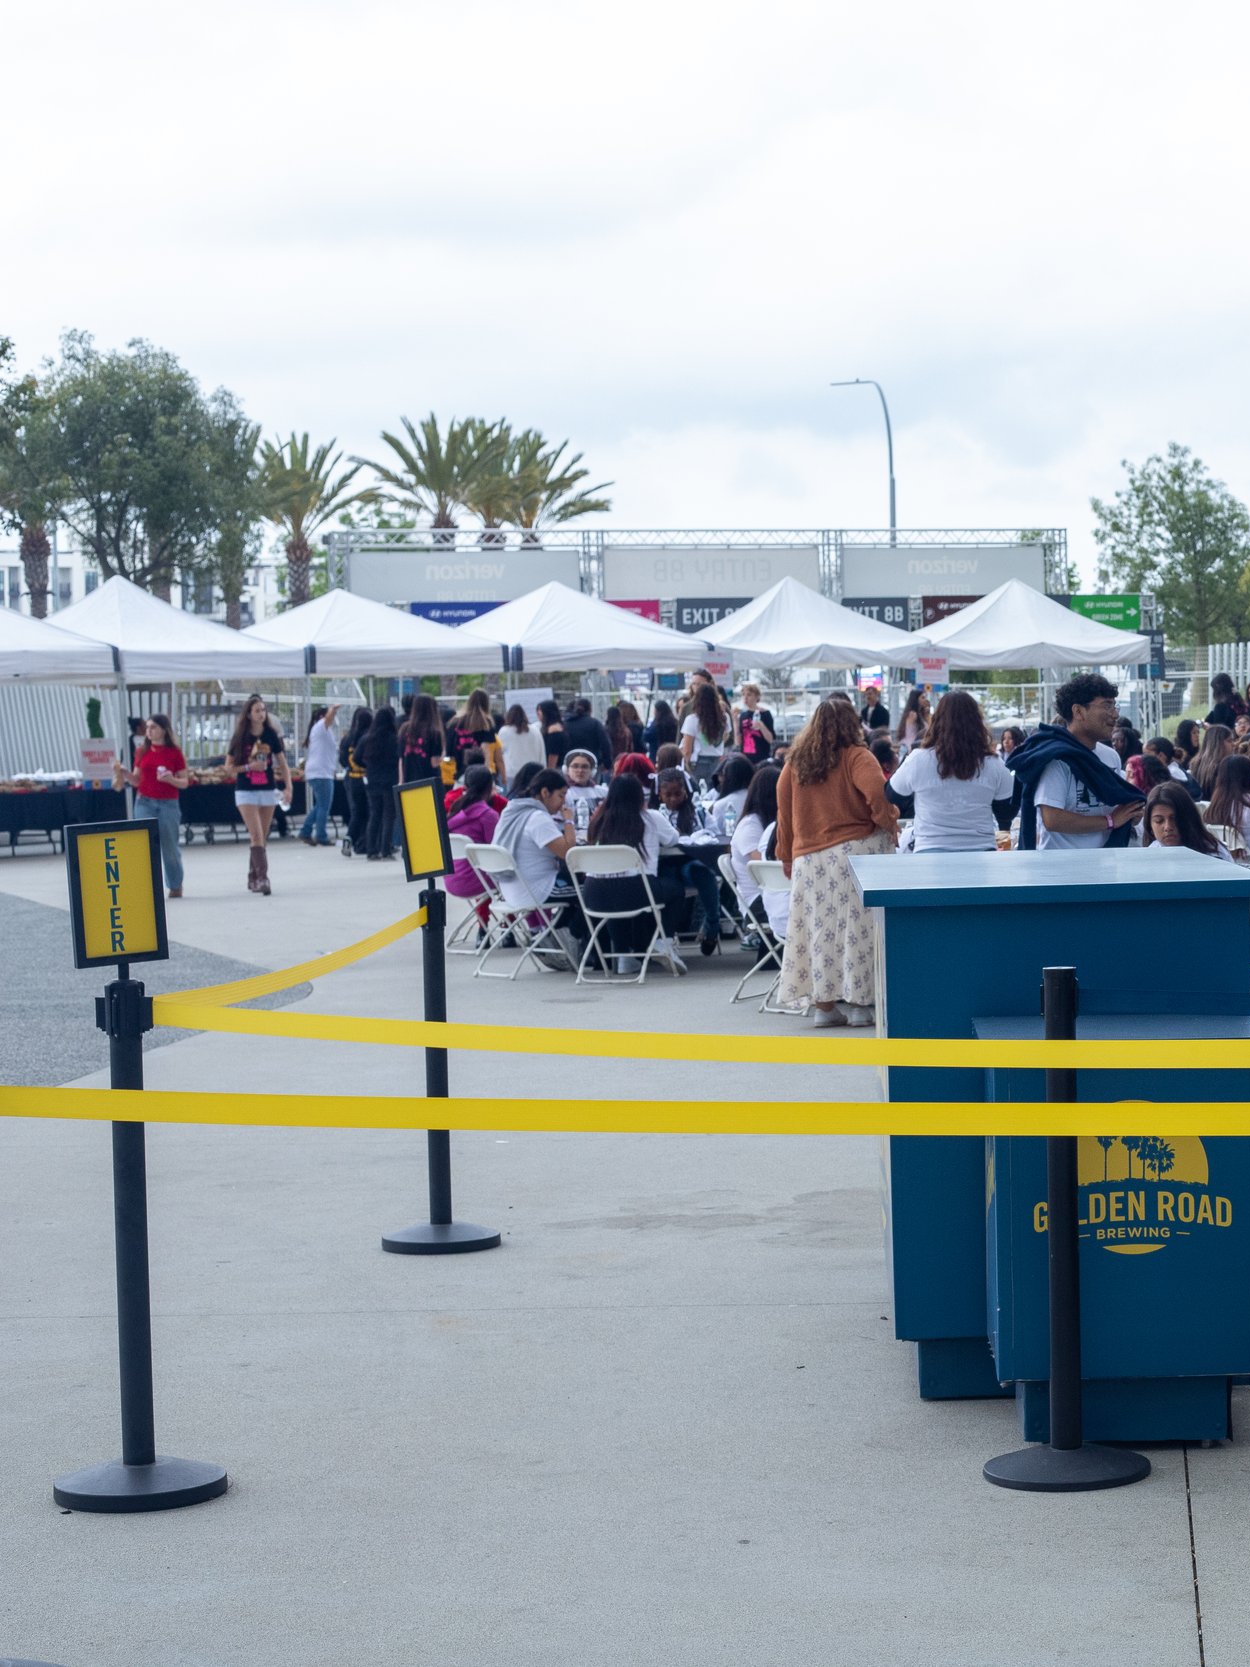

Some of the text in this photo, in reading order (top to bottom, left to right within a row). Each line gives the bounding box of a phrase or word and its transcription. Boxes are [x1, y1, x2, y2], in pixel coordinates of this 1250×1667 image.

[682, 608, 720, 625] EXIT
[884, 606, 904, 622] 8B
[104, 838, 126, 953] ENTER
[1157, 1191, 1232, 1227] ROAD
[1096, 1227, 1171, 1240] BREWING
